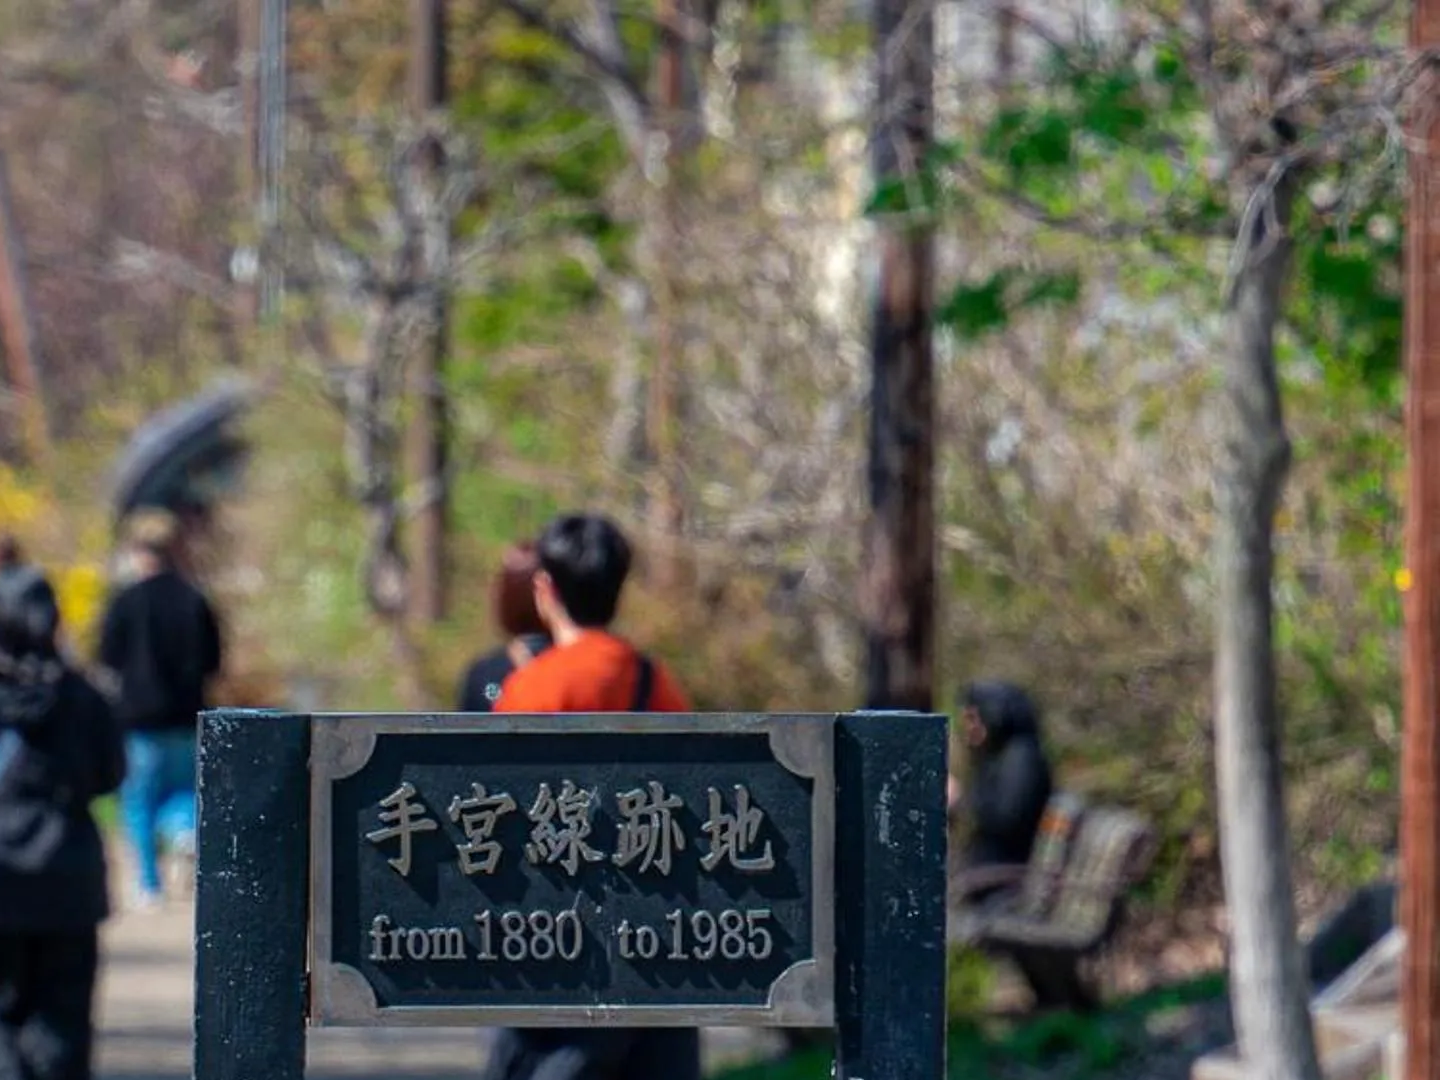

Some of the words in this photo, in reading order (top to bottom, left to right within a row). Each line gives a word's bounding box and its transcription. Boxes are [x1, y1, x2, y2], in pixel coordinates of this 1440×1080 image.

[366, 780, 775, 878] 手宮線跡地
[368, 913, 467, 962] from
[474, 909, 583, 962] 1880
[617, 918, 659, 961] to
[665, 908, 774, 962] 1985
